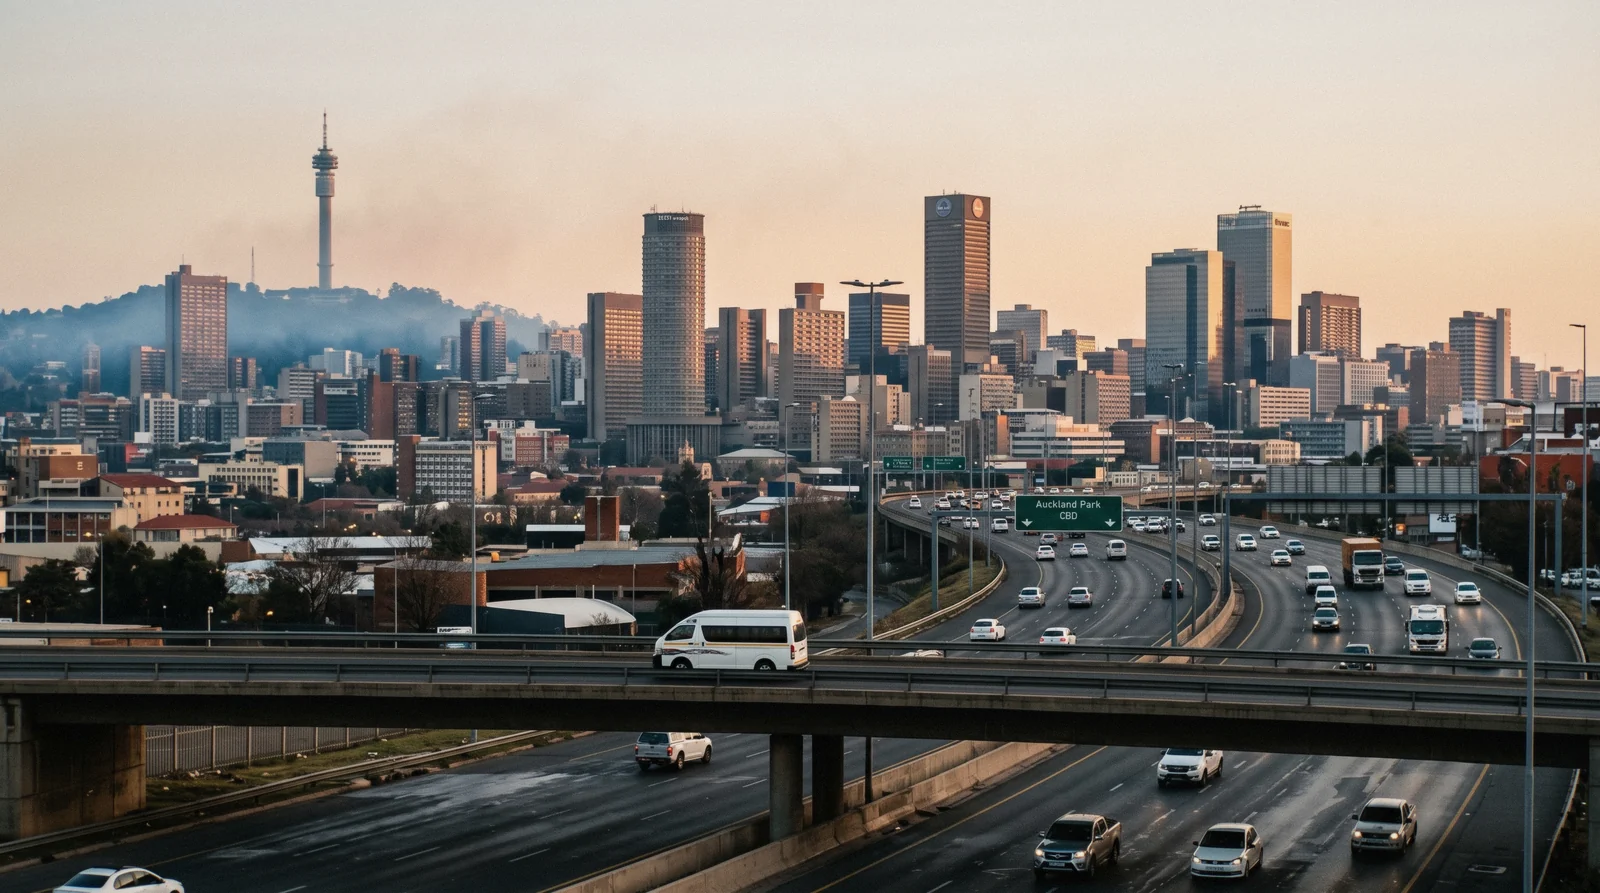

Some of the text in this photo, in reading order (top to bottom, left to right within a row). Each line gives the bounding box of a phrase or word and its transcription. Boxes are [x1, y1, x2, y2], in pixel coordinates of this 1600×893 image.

[1035, 500, 1101, 509] Auckland Park
[1059, 511, 1078, 520] CBD
